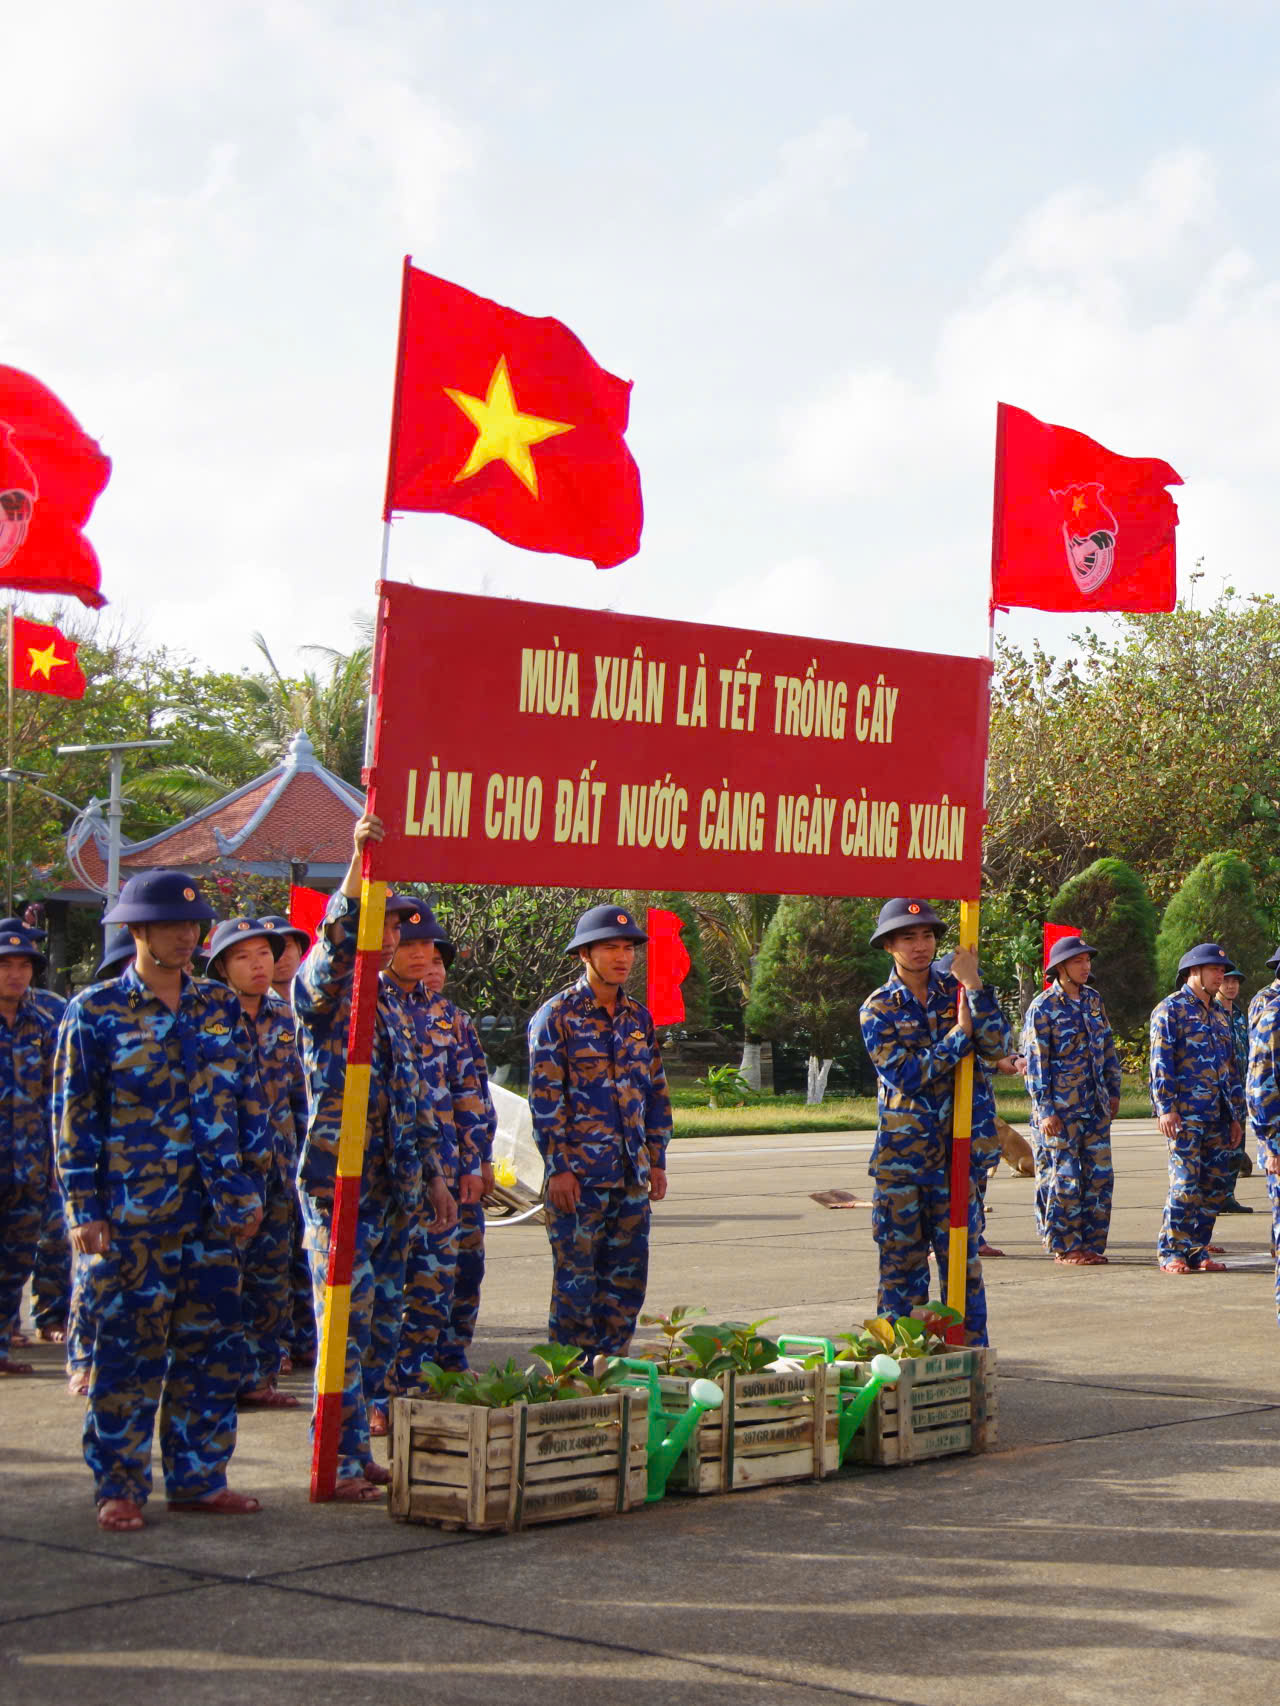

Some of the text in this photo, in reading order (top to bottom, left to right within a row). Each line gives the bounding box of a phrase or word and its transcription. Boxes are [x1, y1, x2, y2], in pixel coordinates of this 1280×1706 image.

[519, 636, 899, 744] MÙA XUÂN LÀ TẾT TRỒNG CÂY
[405, 756, 966, 861] LÀM CHO ĐẤT NƯỚC CÀNG NGÀY CÀNG XUÂN
